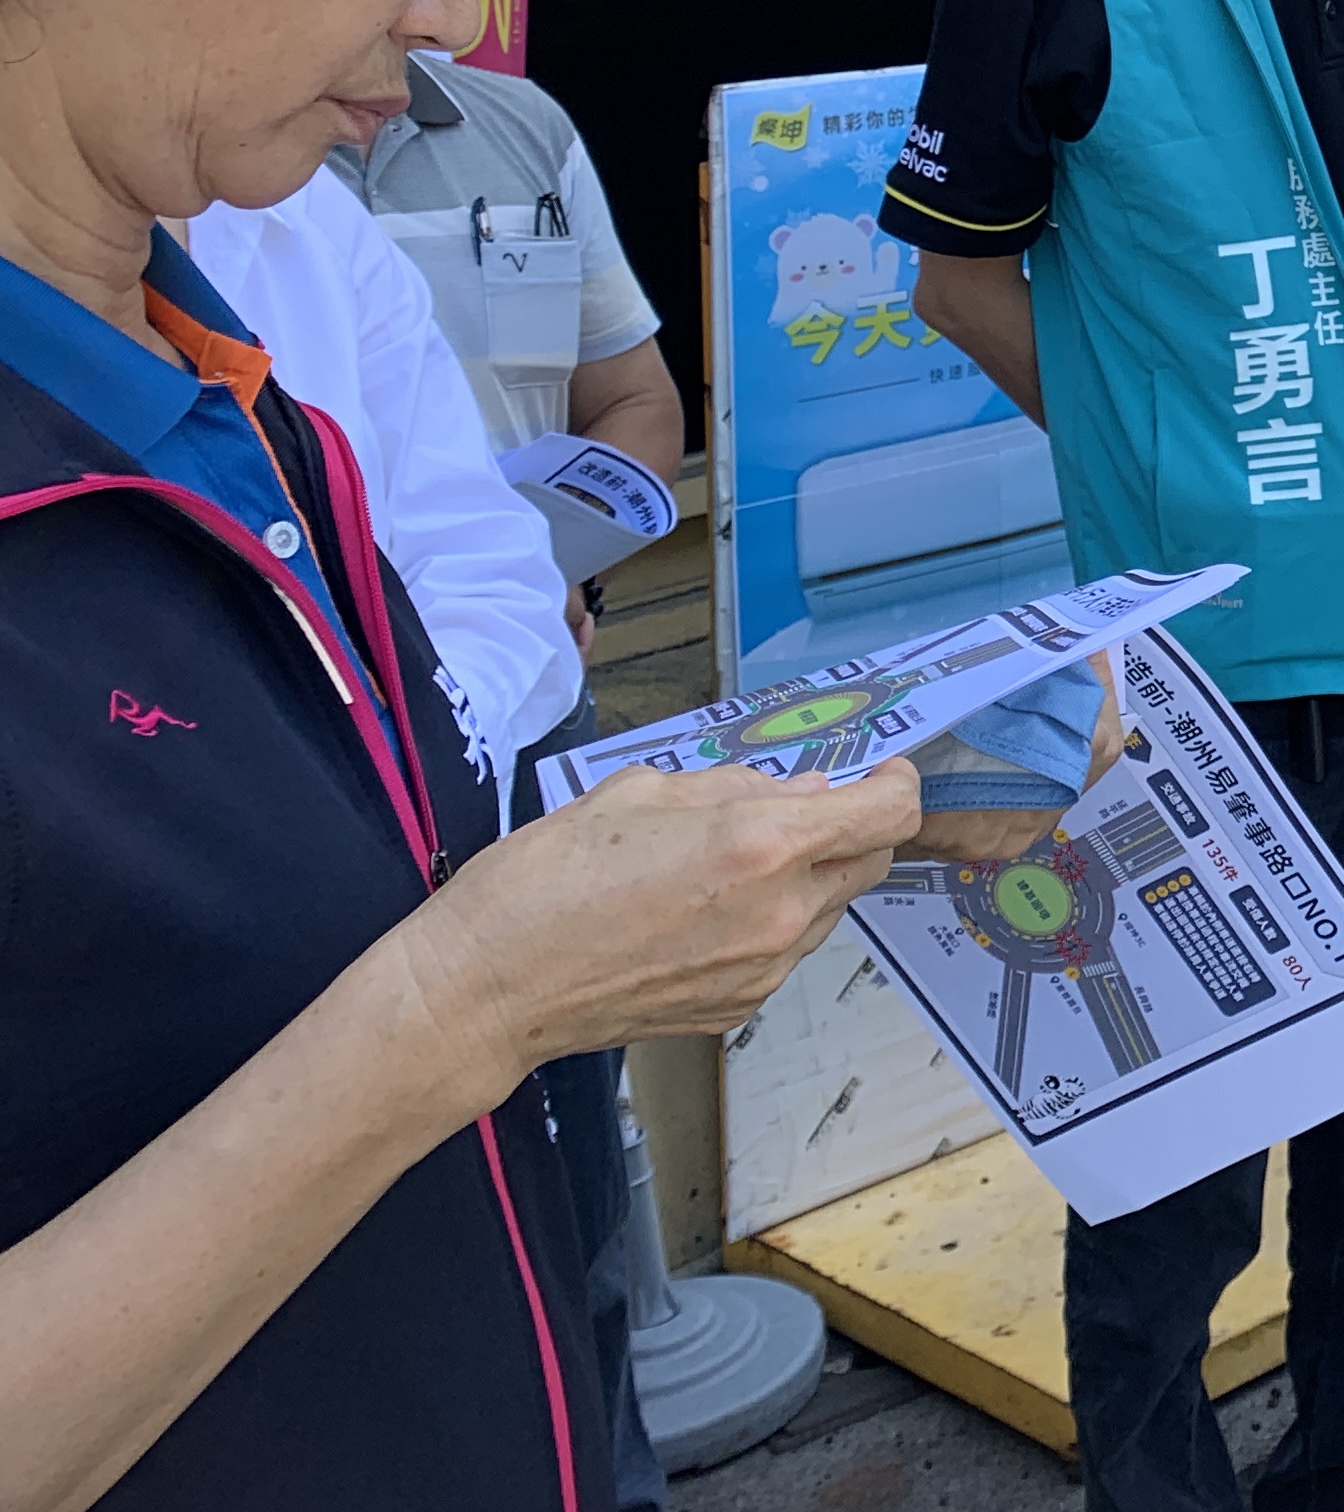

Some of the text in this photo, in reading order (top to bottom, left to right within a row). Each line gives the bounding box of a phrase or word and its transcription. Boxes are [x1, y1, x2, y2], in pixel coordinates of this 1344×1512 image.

[907, 123, 945, 155] obil
[900, 147, 948, 183] elvac
[1217, 235, 1323, 505] 丁勇言
[1200, 836, 1240, 884] 135件
[1281, 953, 1315, 992] 80人
